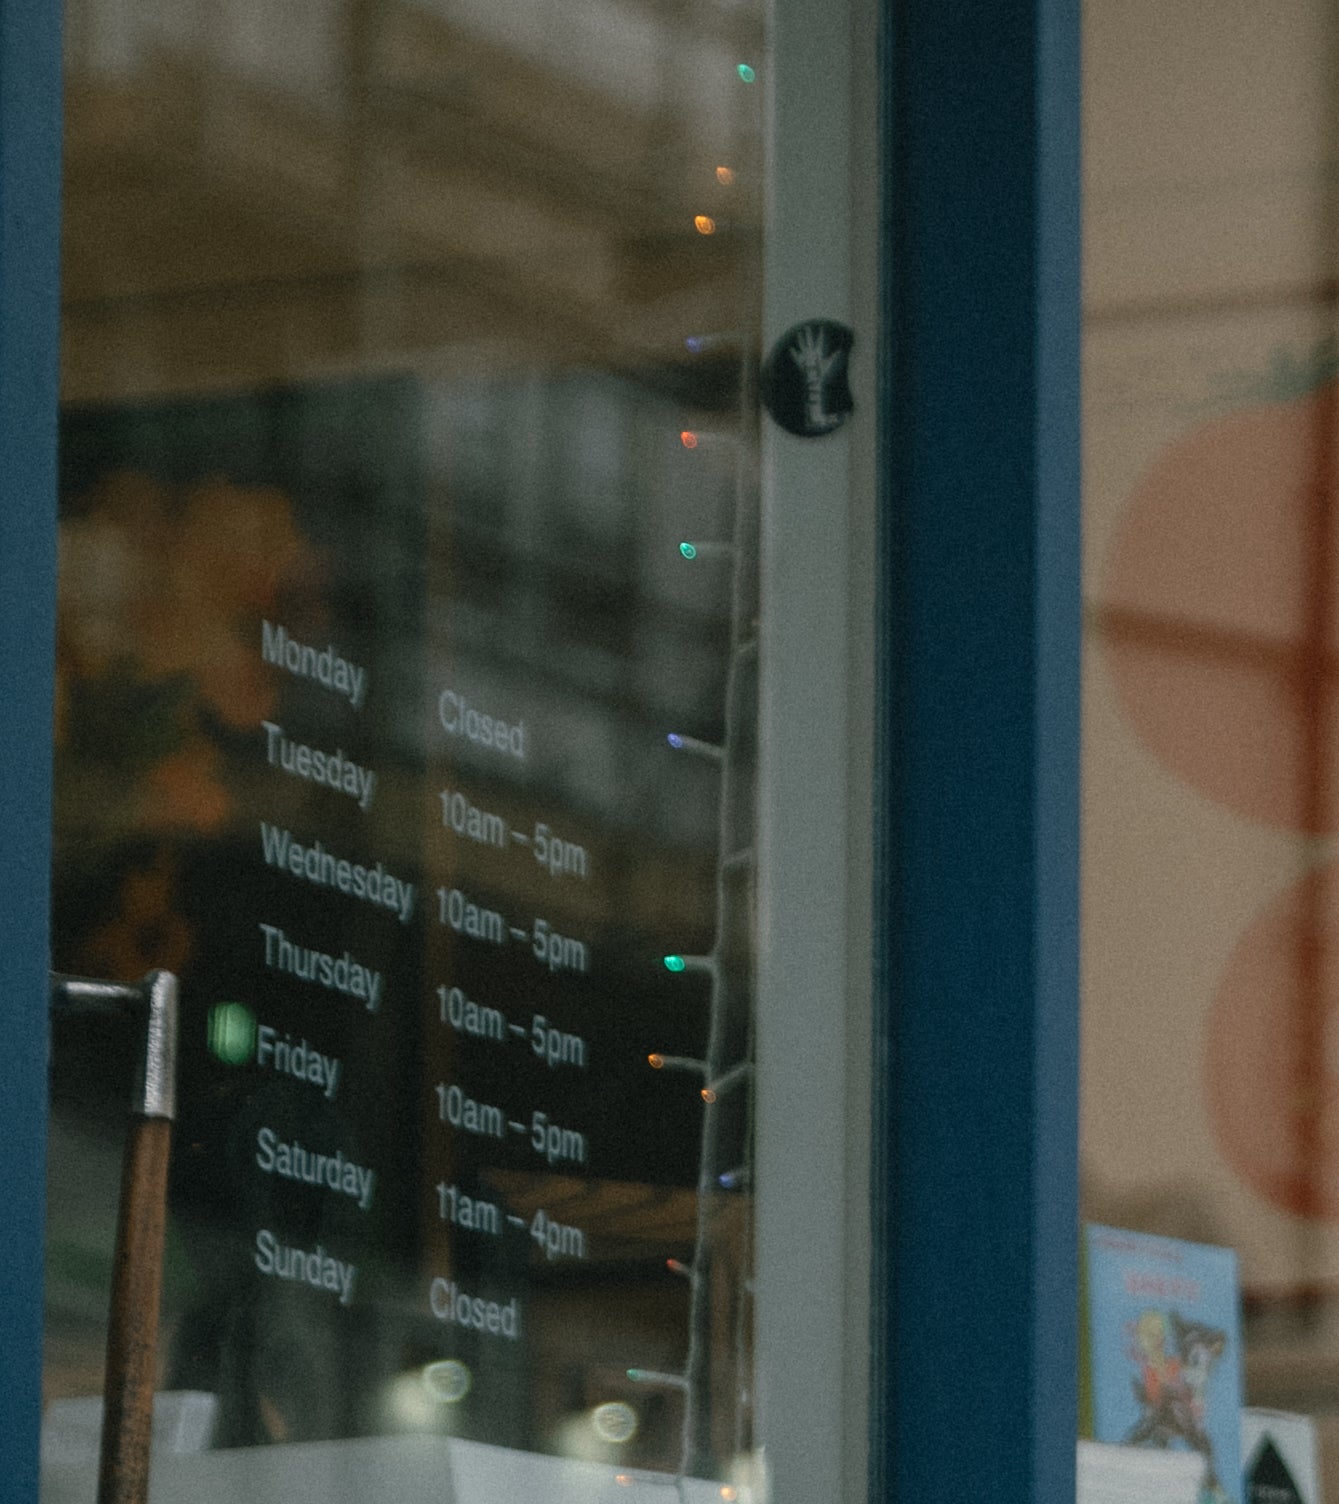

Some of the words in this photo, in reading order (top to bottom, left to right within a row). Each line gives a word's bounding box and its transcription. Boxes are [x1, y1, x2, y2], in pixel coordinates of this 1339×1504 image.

[262, 620, 364, 705] Monday
[438, 689, 525, 760] Closed
[263, 721, 374, 806] Tuesday
[439, 788, 505, 847] 10am
[533, 824, 586, 878] 5pm
[261, 823, 412, 921] Wednesday
[437, 887, 503, 946] 10am
[532, 918, 586, 973] 5pm
[260, 924, 379, 1009] Thursday
[437, 984, 501, 1043] 10am
[532, 1013, 585, 1068] 5pm
[258, 1027, 338, 1098] Friday
[436, 1083, 501, 1139] 10am
[532, 1109, 585, 1164] 5pm
[256, 1127, 375, 1206] Saturday
[437, 1181, 499, 1237] 11am
[530, 1210, 584, 1260] 4pm
[255, 1229, 355, 1304] Sunday
[429, 1278, 519, 1339] Closed
